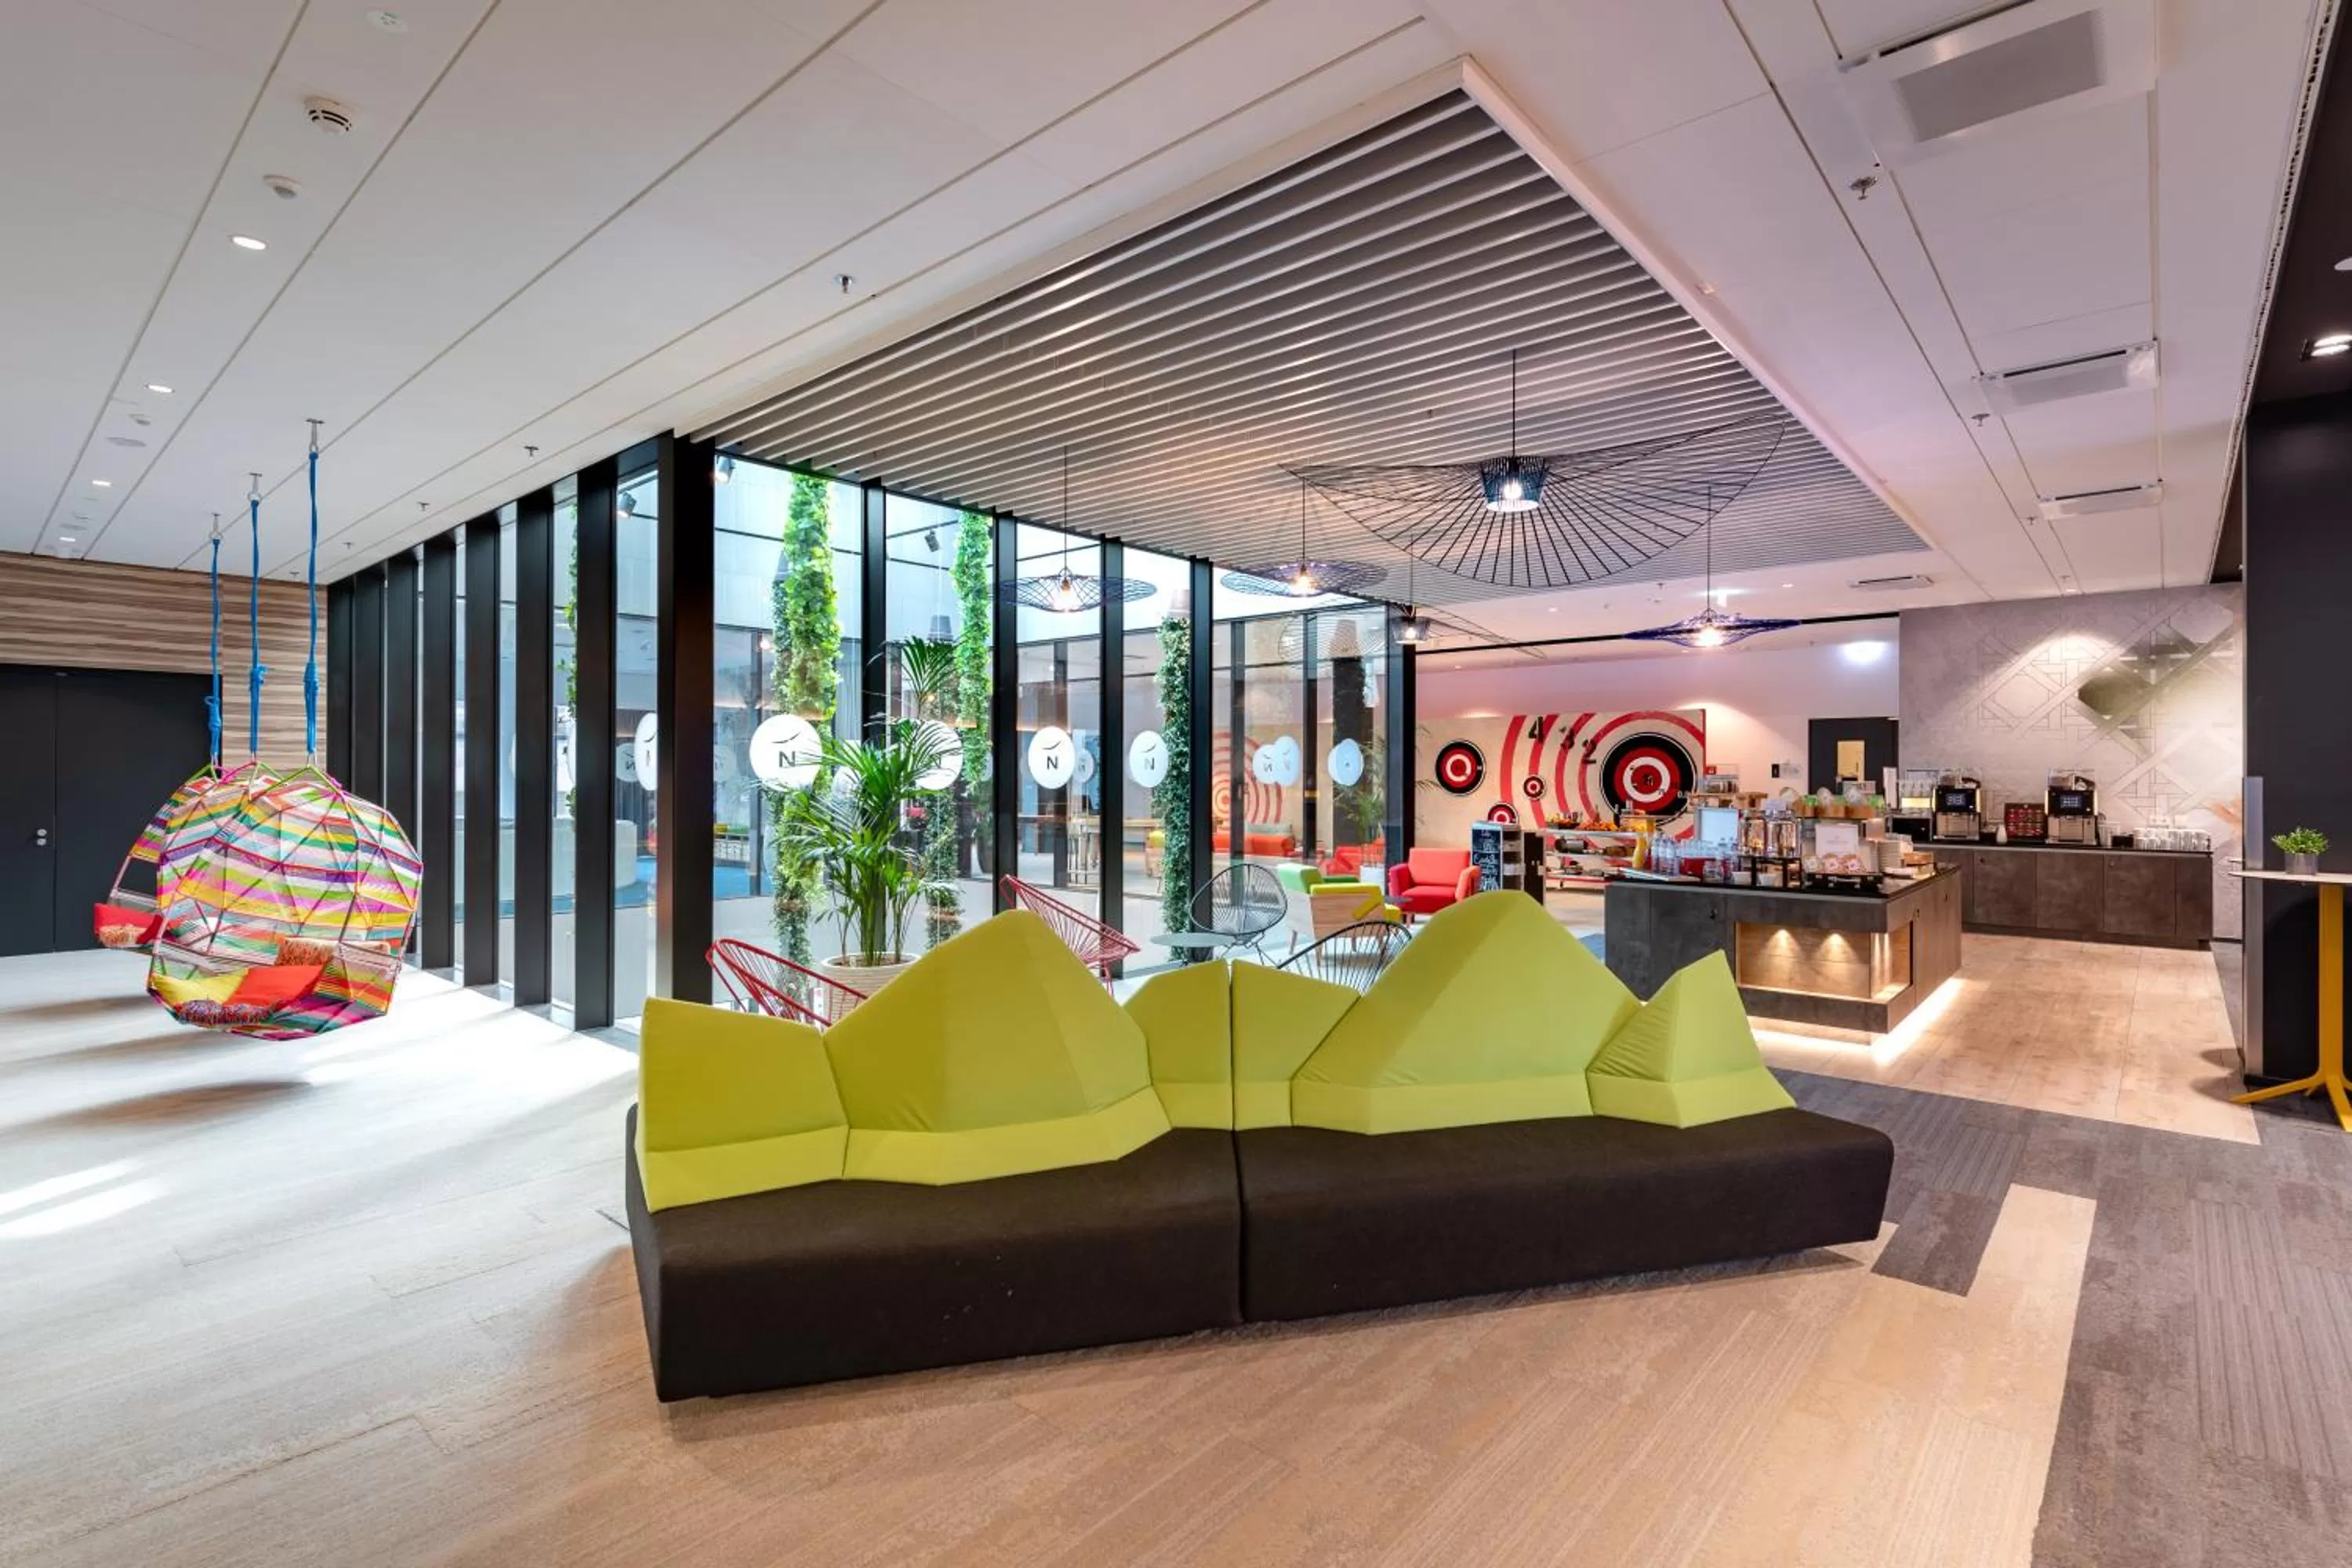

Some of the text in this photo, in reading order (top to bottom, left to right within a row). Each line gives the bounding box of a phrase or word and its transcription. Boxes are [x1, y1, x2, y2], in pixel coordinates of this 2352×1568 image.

[1528, 717, 1544, 743] 4
[1582, 739, 1597, 764] 2
[779, 751, 796, 768] N
[1047, 756, 1058, 770] N
[1144, 757, 1154, 771] N
